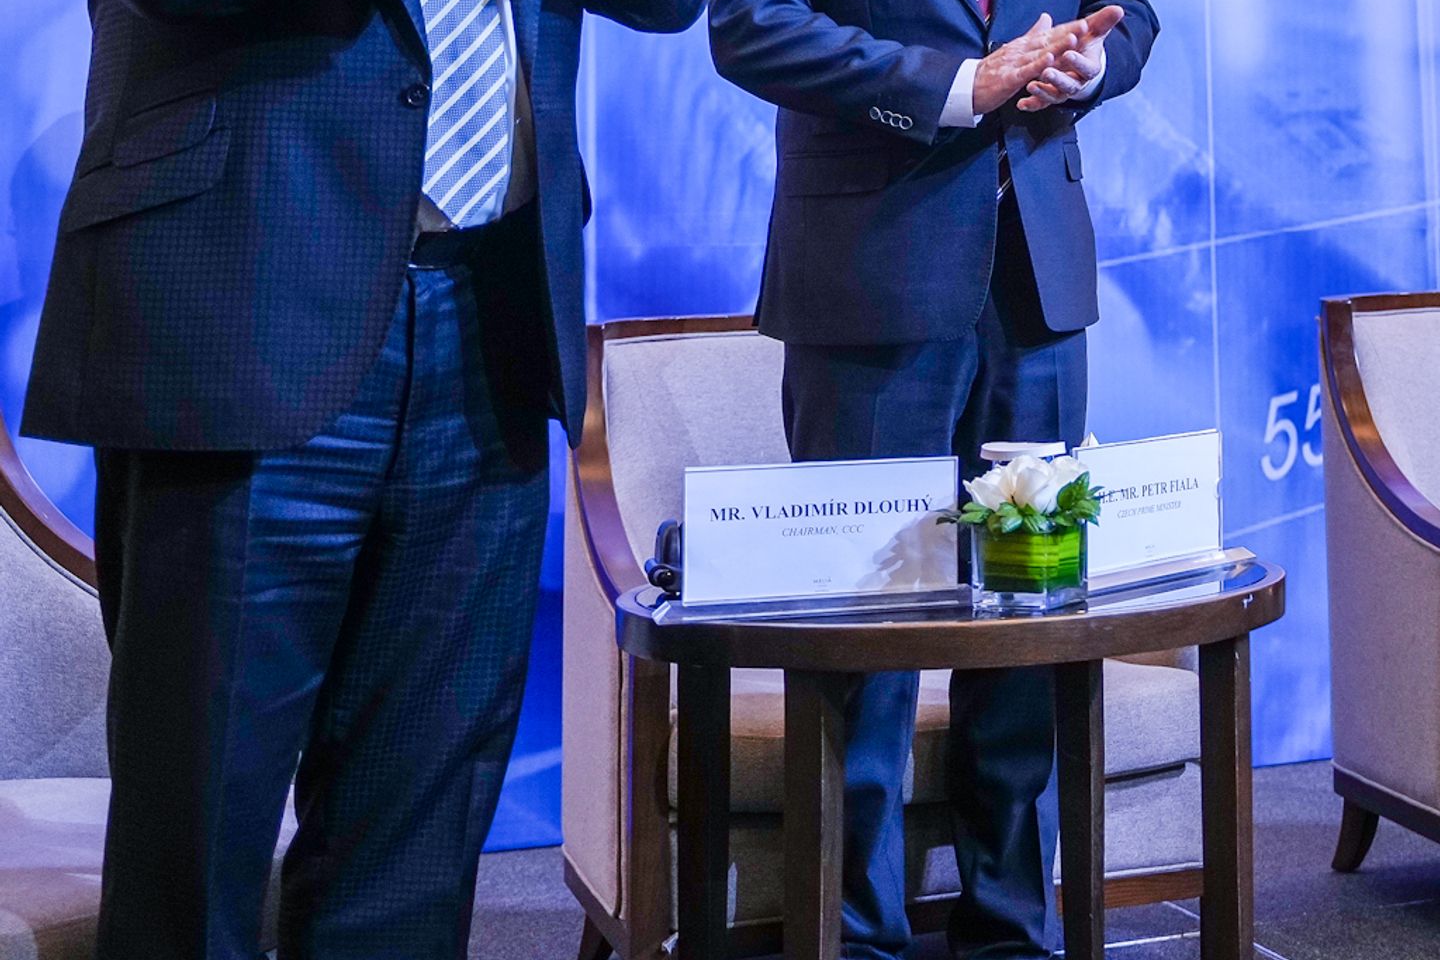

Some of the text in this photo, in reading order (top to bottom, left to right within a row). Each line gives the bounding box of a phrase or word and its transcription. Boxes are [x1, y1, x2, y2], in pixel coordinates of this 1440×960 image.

[1142, 482, 1167, 497] PETR
[1170, 477, 1199, 493] FIALA
[710, 494, 933, 522] MR. VLADIMÍR DLOUHÝ
[842, 524, 864, 534] CCC
